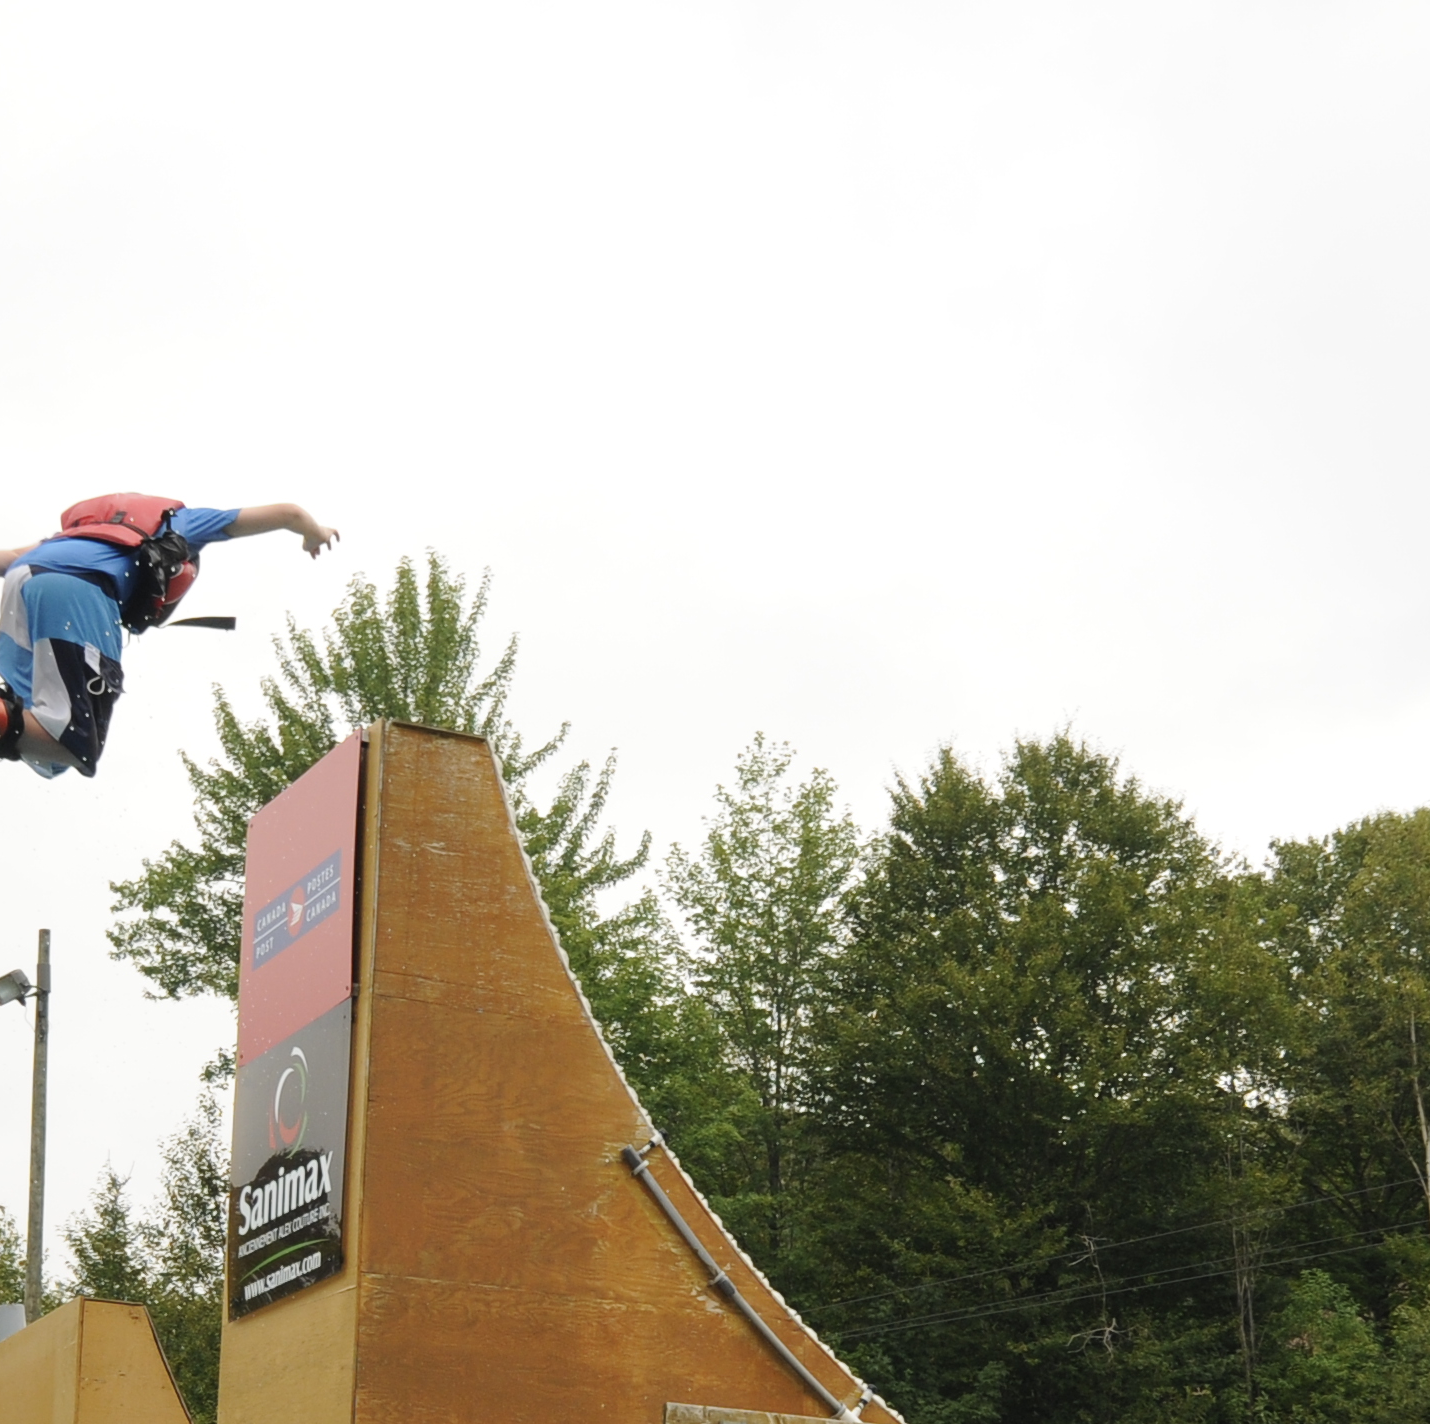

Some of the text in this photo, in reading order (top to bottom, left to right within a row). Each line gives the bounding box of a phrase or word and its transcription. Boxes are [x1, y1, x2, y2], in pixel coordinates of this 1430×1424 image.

[306, 864, 334, 895] POSTES
[256, 902, 286, 932] CANADA
[306, 891, 337, 922] CANADA
[255, 937, 274, 959] POST
[238, 1151, 333, 1236] Sanimax
[244, 1251, 321, 1301] www.sanimax.com
